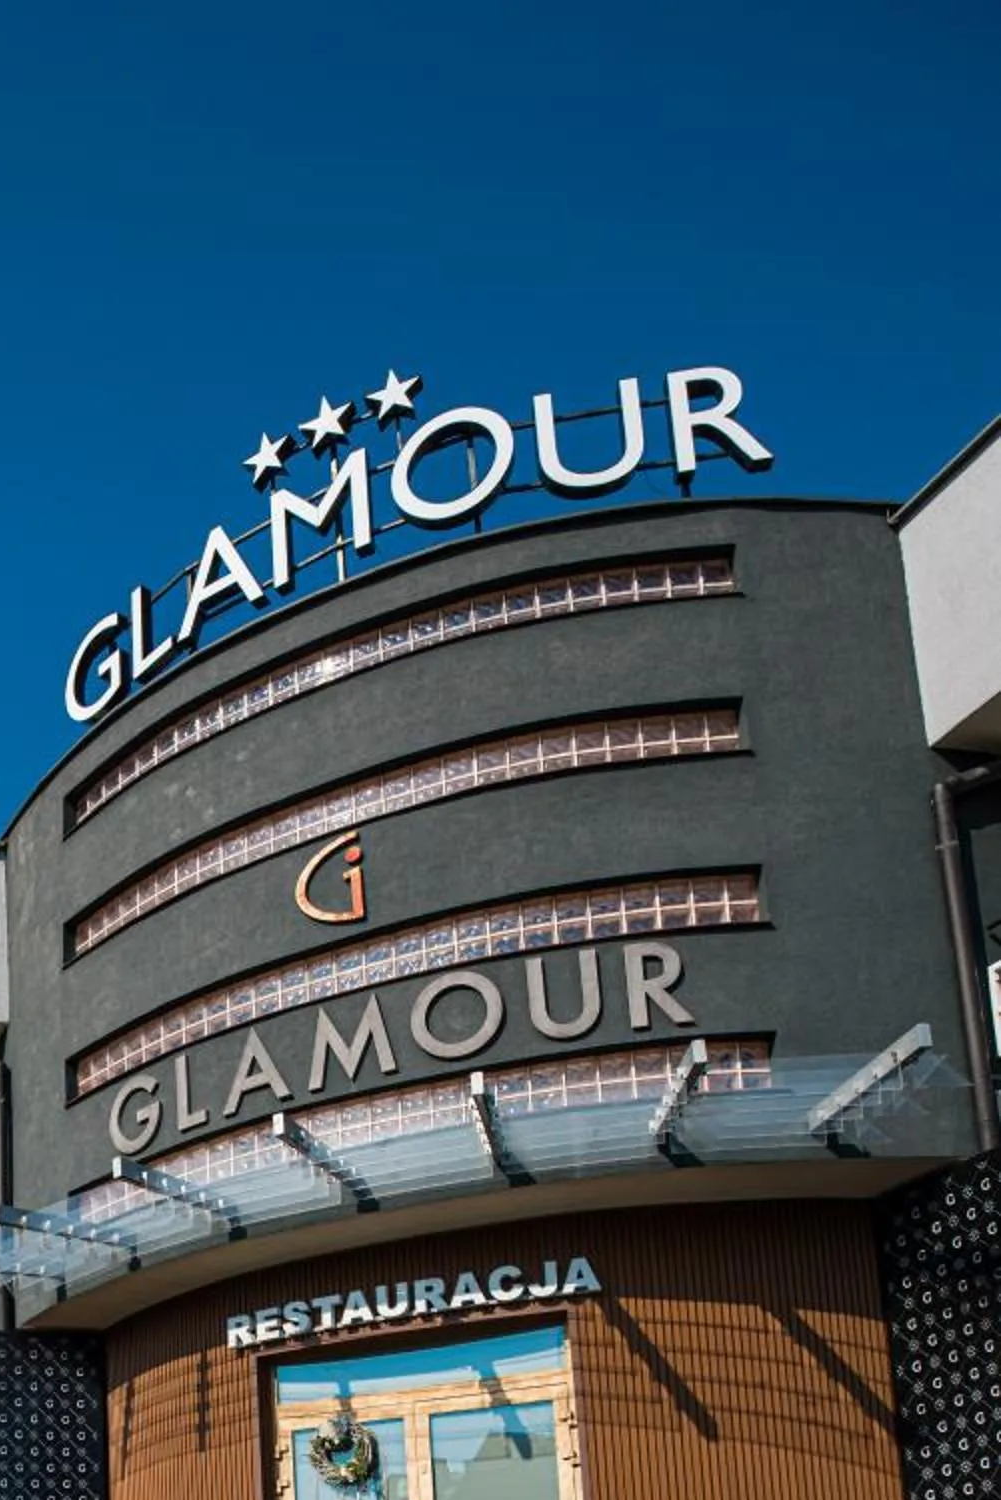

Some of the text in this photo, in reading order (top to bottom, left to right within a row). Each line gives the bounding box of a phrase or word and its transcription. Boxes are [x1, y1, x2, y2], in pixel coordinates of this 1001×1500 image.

[64, 367, 774, 722] GLAMOUR
[108, 941, 696, 1155] GLAMOUR
[225, 1256, 601, 1349] RESTAURACJA
